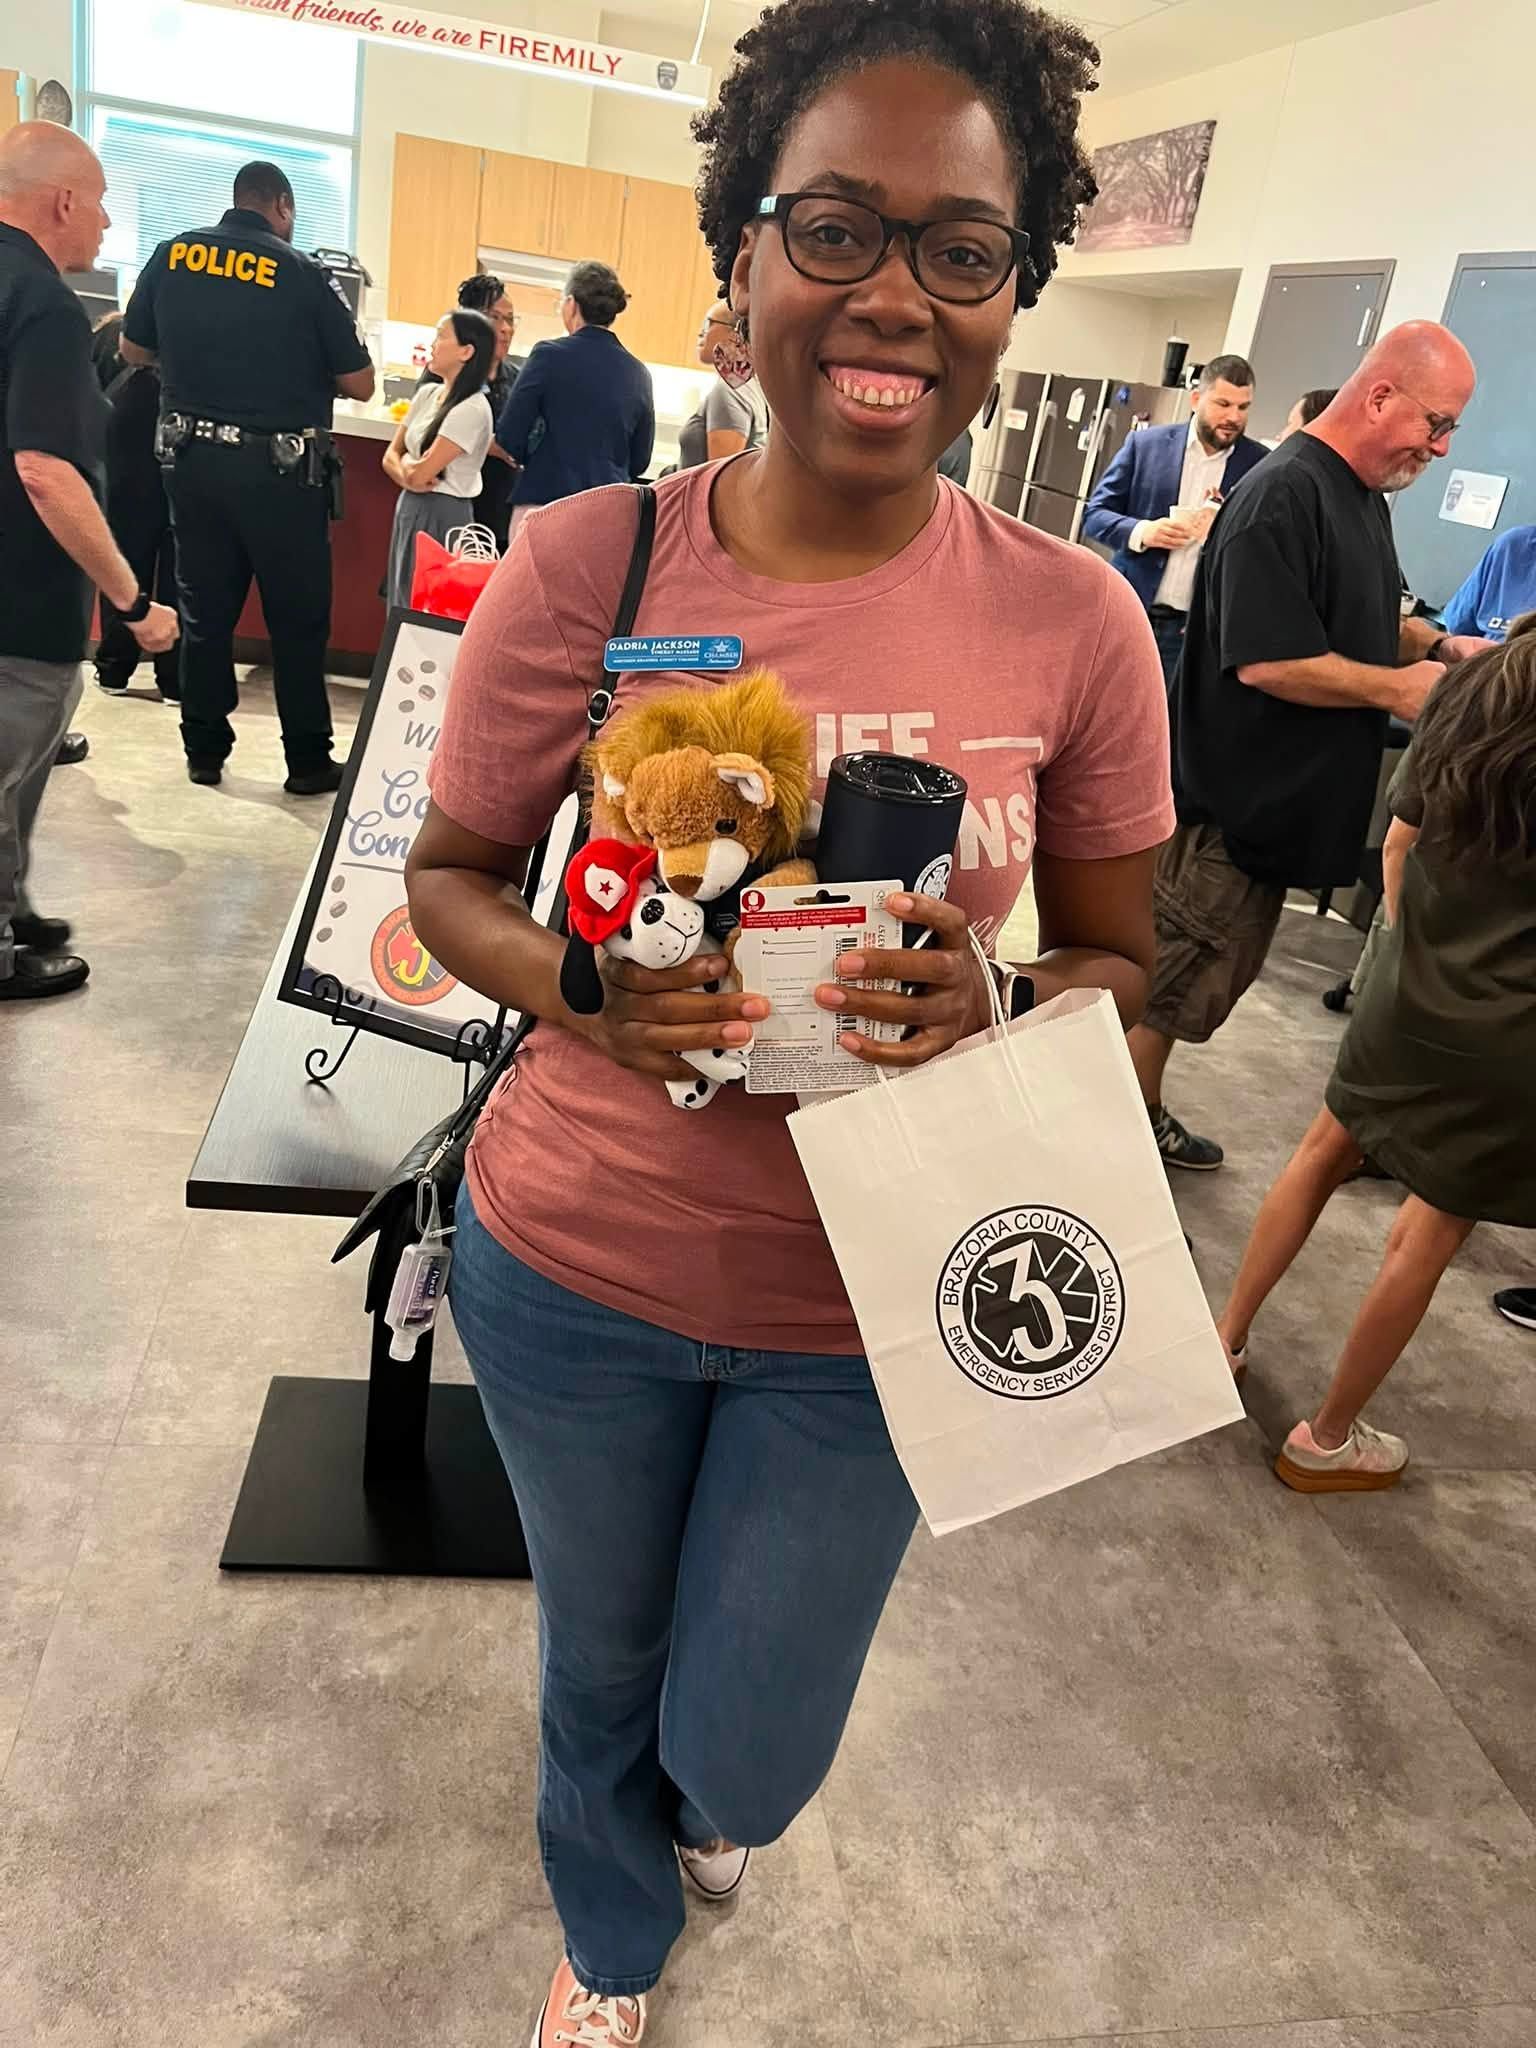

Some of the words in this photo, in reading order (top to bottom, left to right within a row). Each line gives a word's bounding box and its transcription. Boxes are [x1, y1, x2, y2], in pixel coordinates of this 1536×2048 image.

[391, 18, 427, 38] we
[431, 27, 473, 47] are
[479, 29, 623, 76] FIREMILY
[168, 242, 279, 288] POLICE
[608, 641, 649, 651] DADRIA
[651, 640, 700, 651] JACKSON
[944, 1219, 1012, 1306] BRAZORIA
[1014, 1212, 1097, 1252] COUNTY
[948, 1325, 1030, 1393] EMERGENCY
[1033, 1343, 1104, 1392] SERVICES
[1096, 1268, 1116, 1342] DISTRICT
